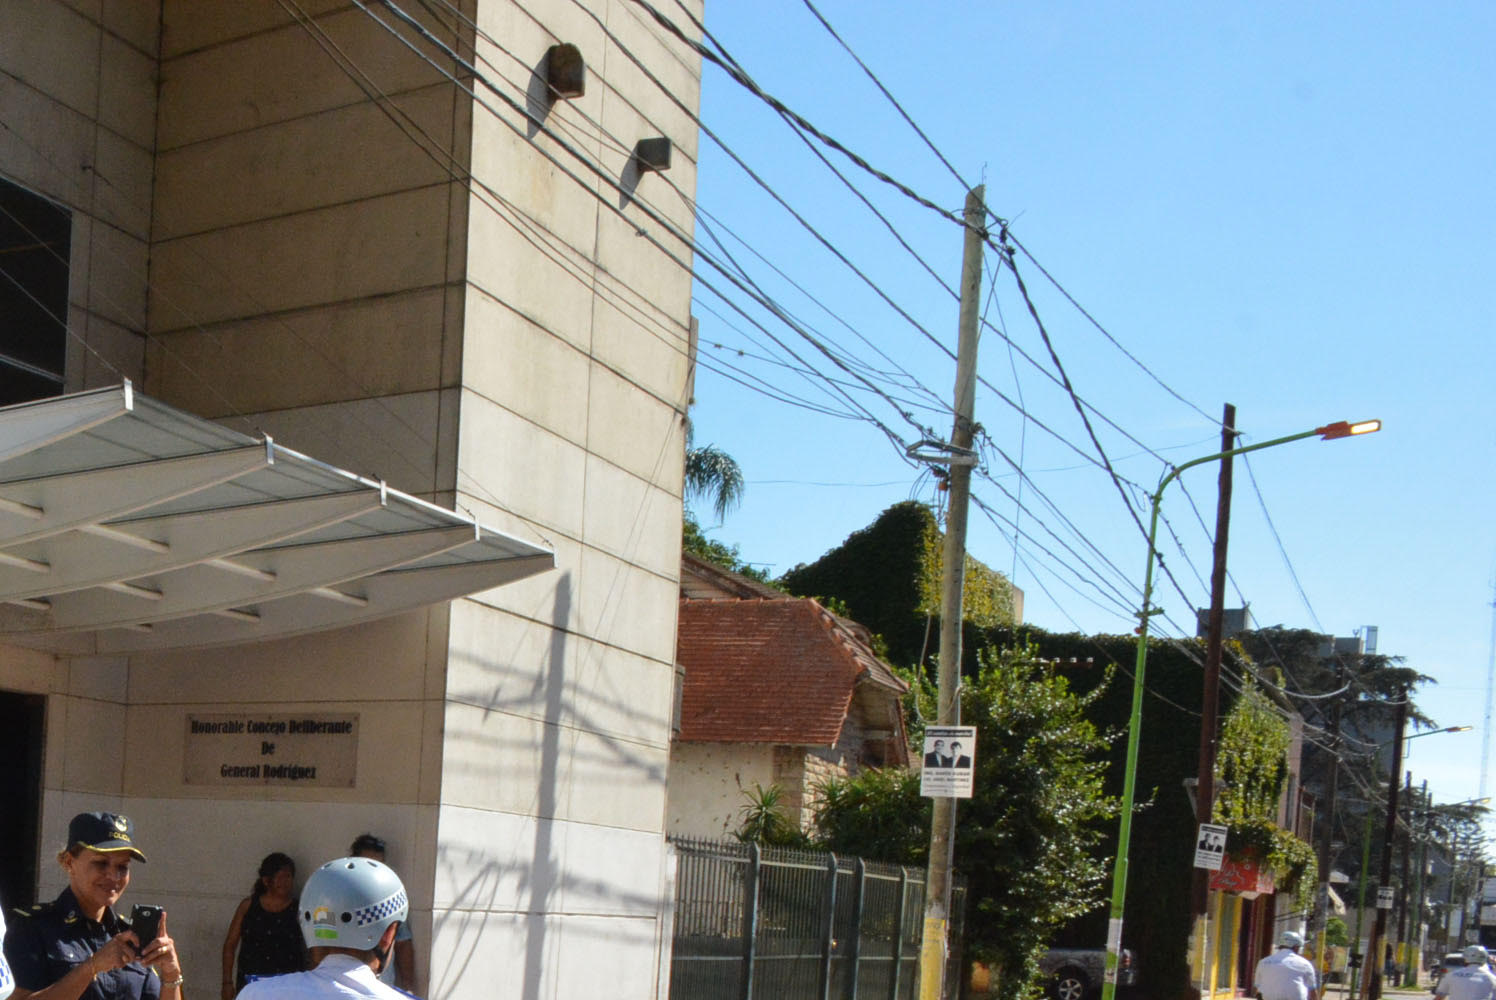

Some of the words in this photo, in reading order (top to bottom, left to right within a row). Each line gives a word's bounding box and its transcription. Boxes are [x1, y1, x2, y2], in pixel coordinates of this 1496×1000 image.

[191, 720, 244, 734] Honorable
[247, 720, 286, 735] Concejo
[289, 720, 352, 734] Deliberante
[261, 741, 276, 755] De
[220, 764, 260, 778] General
